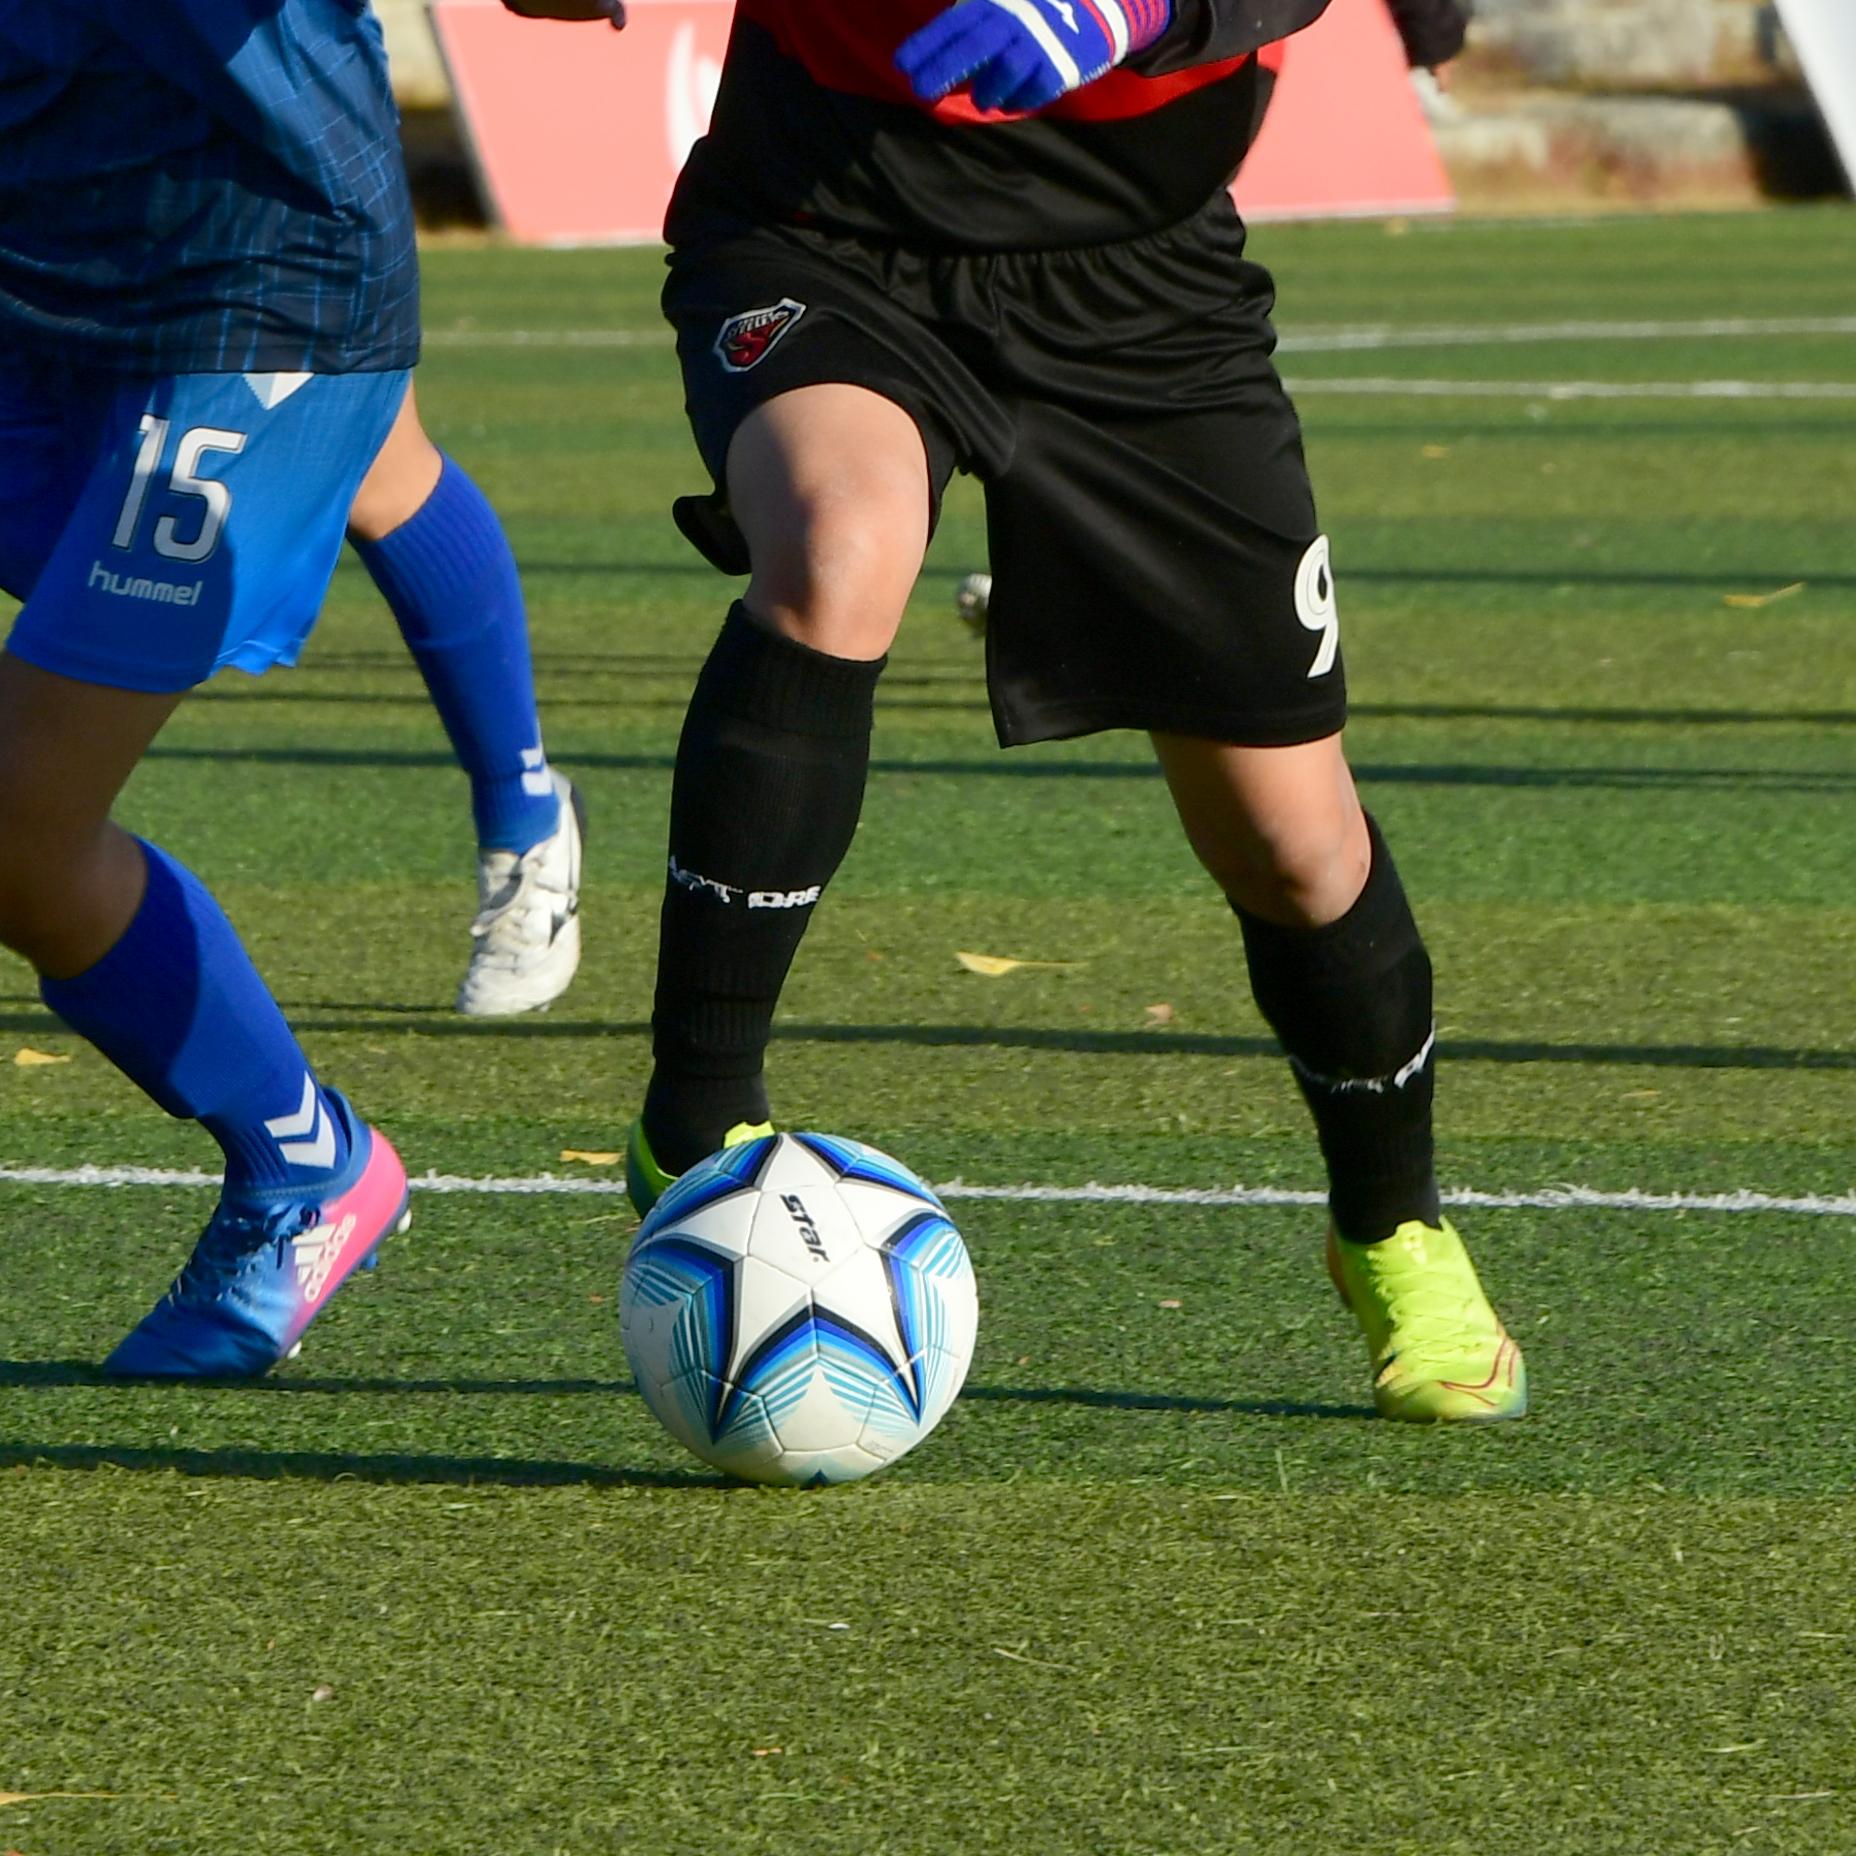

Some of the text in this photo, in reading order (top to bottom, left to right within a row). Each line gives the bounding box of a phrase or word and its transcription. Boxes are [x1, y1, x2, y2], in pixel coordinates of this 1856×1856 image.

[111, 413, 248, 564] 15
[87, 560, 204, 607] hummel
[1294, 533, 1339, 679] 9
